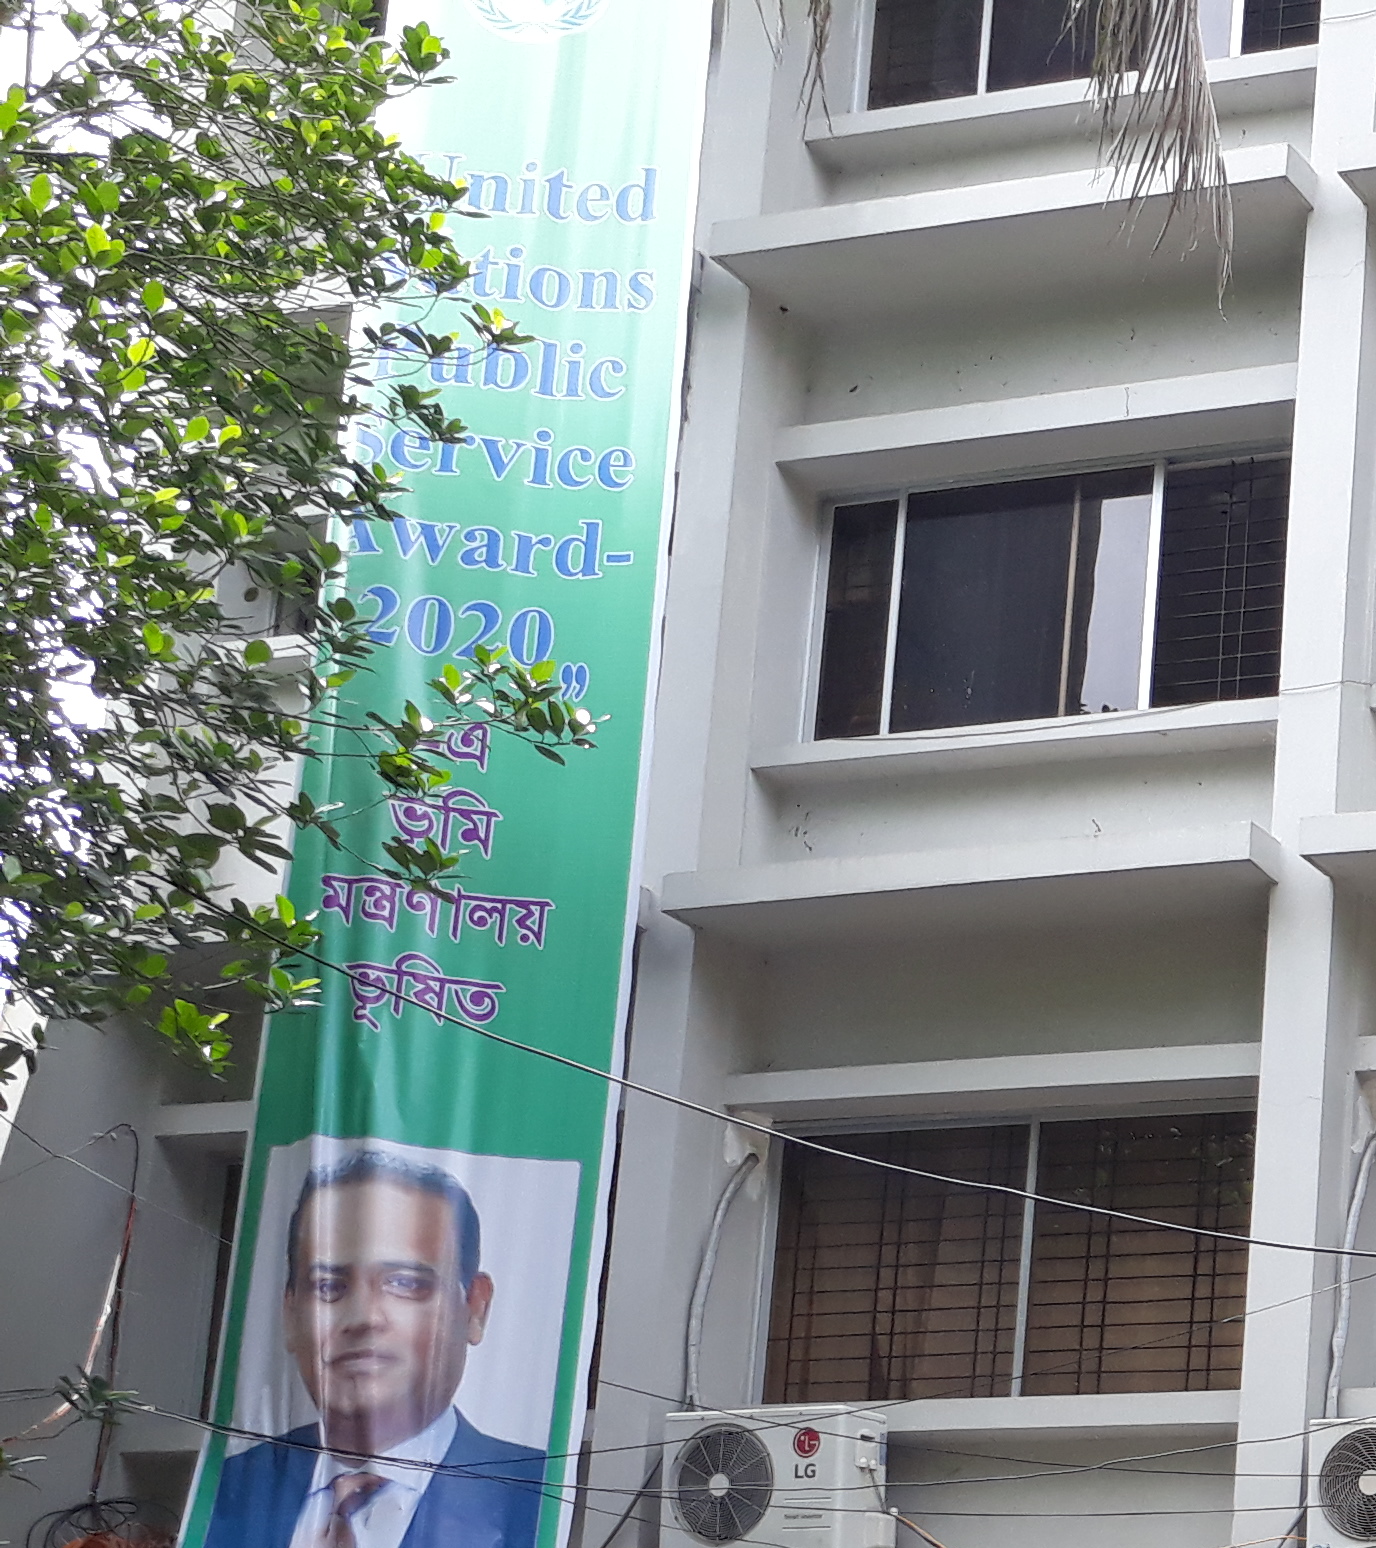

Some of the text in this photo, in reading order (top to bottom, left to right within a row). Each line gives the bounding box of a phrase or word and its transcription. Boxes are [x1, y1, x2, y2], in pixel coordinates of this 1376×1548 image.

[378, 246, 655, 310] tions
[352, 416, 636, 490] Service
[344, 951, 506, 1032] ভূষিত
[794, 1463, 817, 1479] LG
